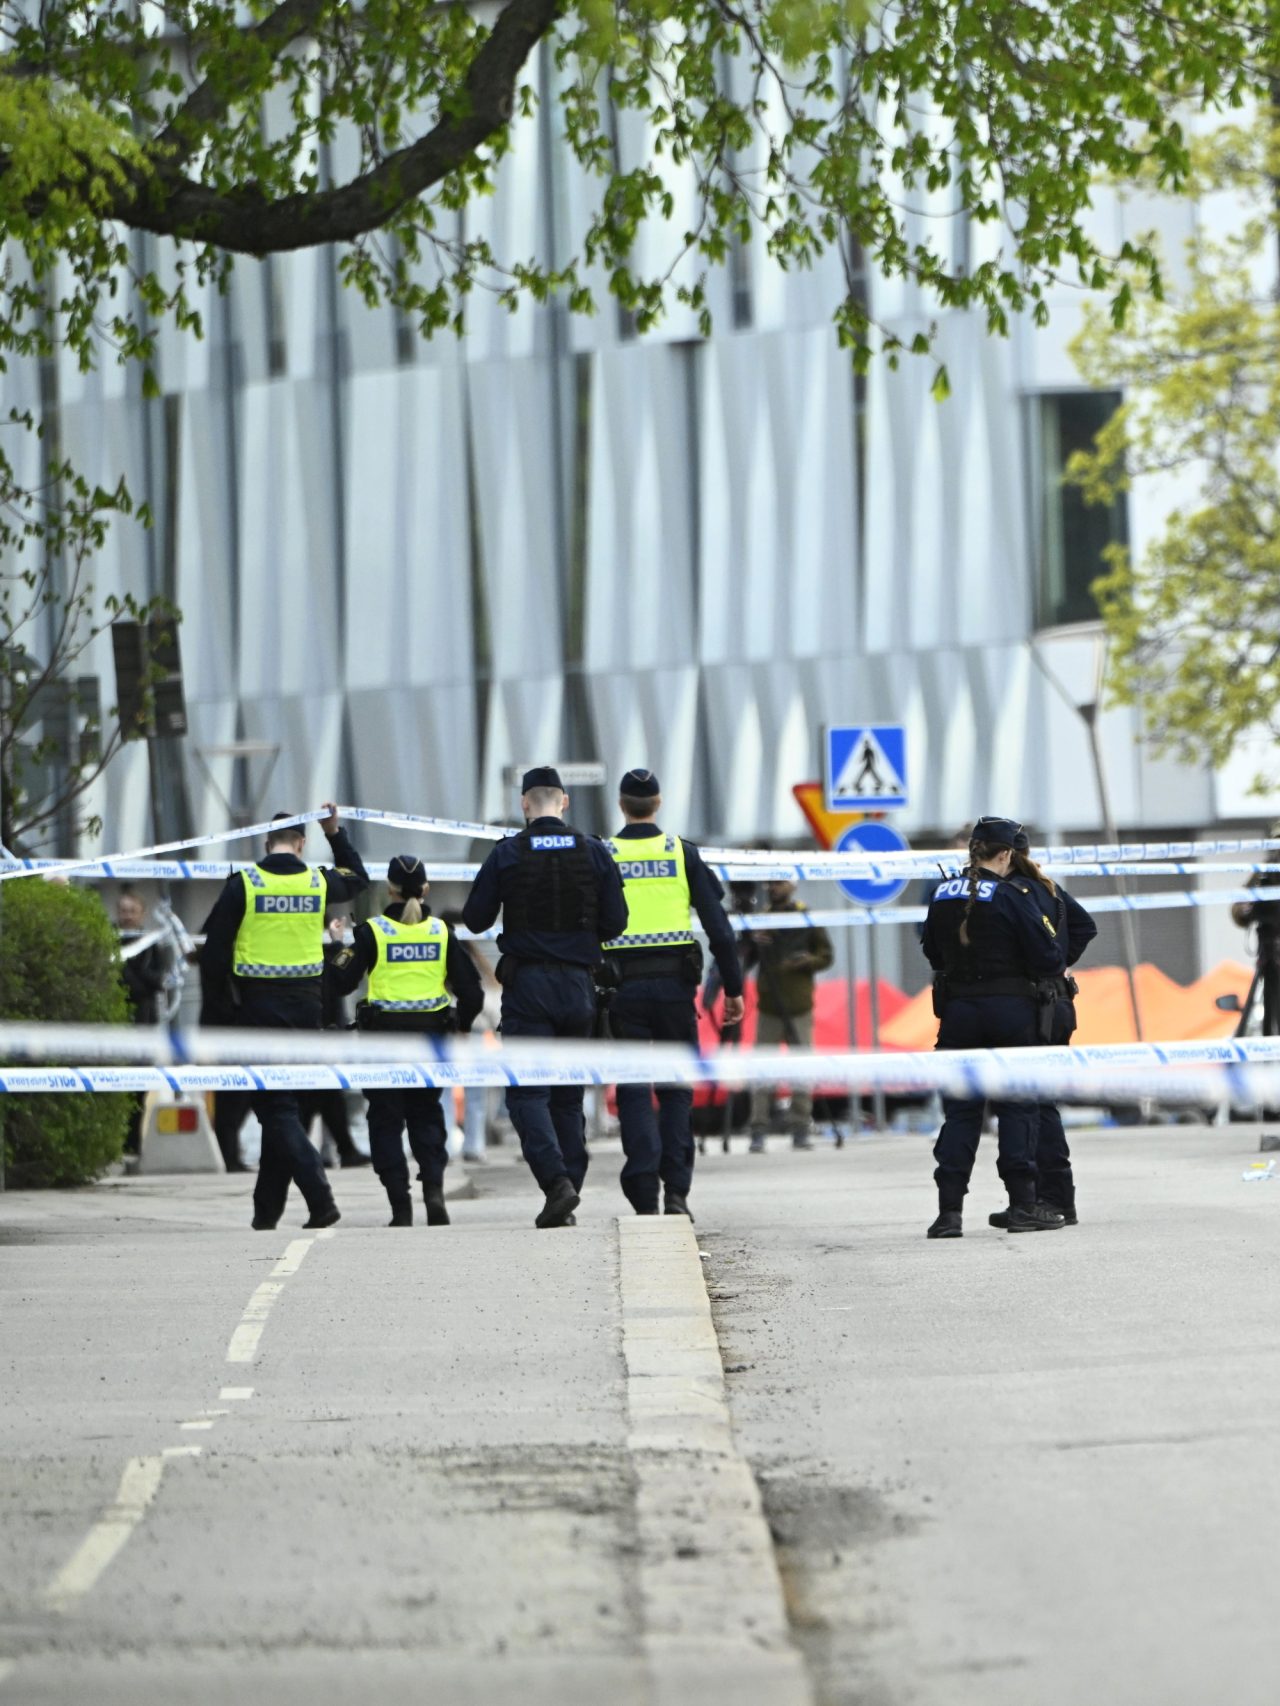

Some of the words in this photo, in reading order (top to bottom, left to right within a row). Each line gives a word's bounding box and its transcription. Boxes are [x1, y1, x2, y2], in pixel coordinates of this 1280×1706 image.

[533, 836, 574, 849] POLIS
[618, 860, 671, 878] POLIS
[264, 895, 314, 913] POLIS
[391, 944, 437, 960] POLIS
[48, 1076, 77, 1088] POLIS
